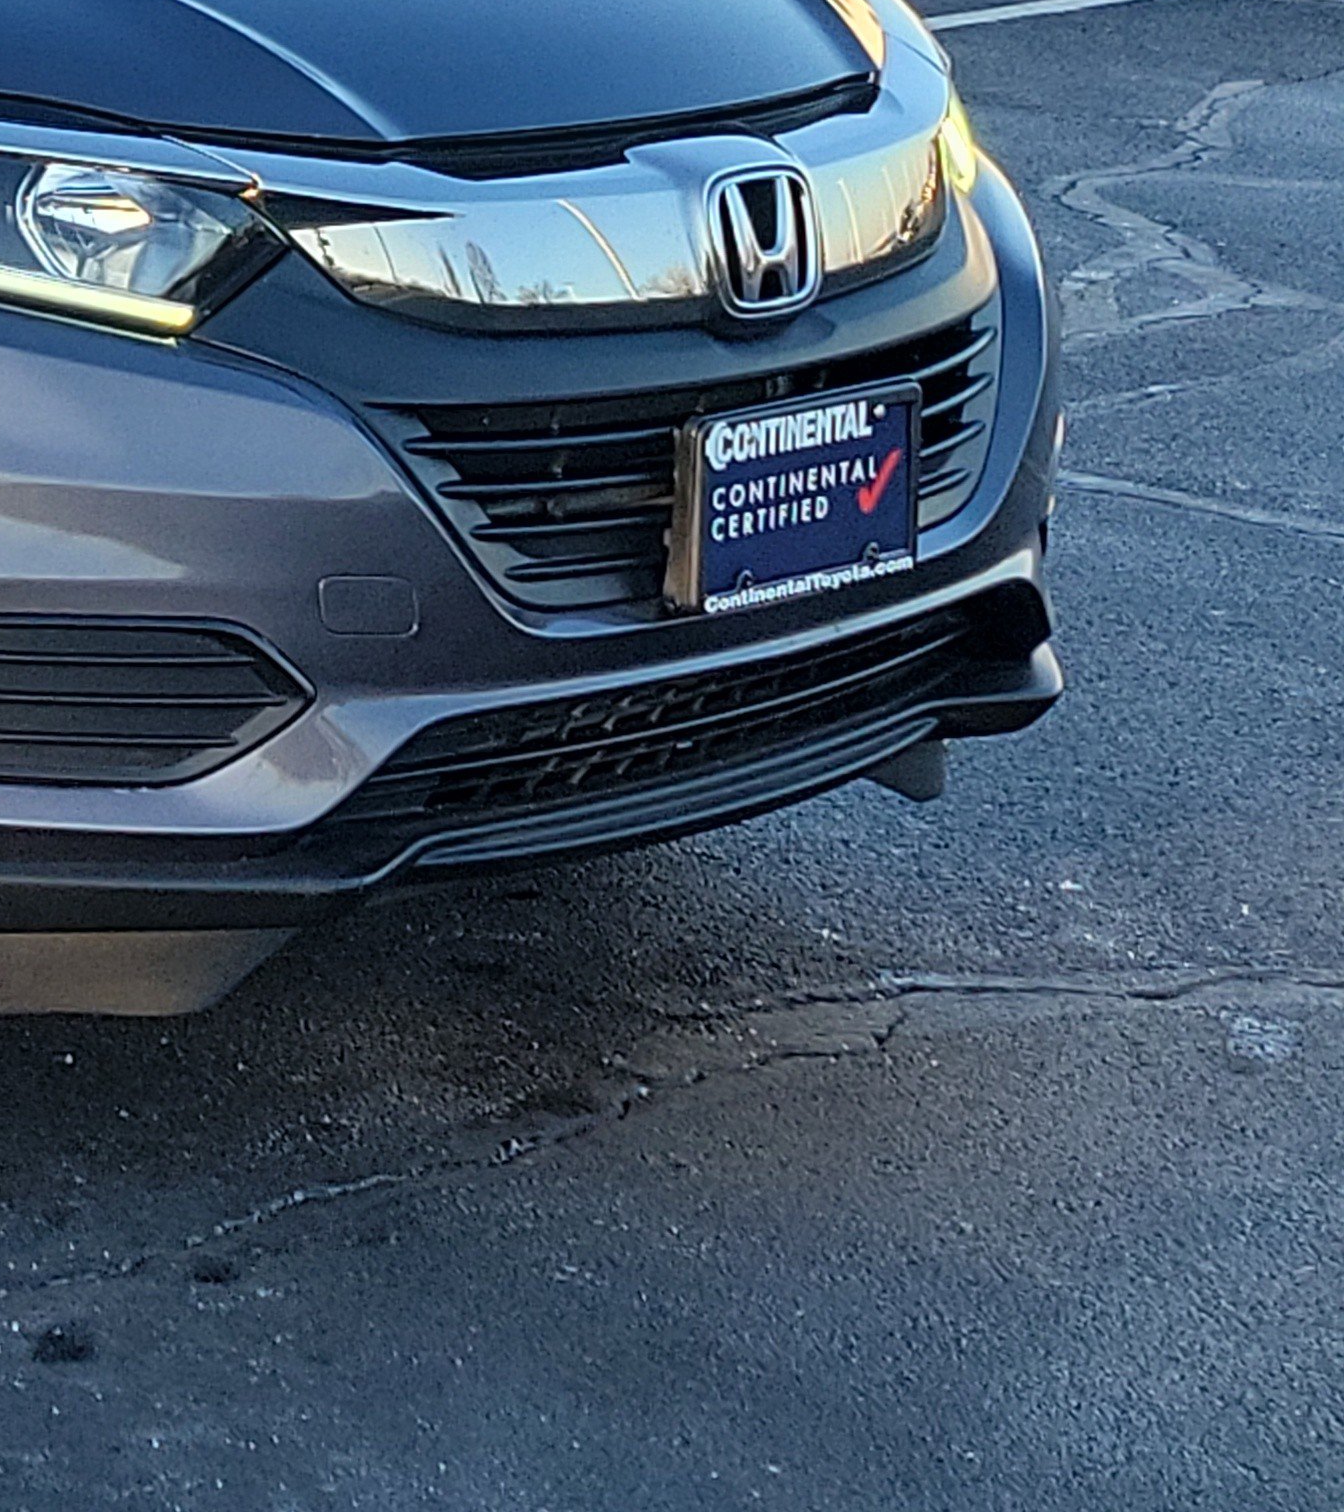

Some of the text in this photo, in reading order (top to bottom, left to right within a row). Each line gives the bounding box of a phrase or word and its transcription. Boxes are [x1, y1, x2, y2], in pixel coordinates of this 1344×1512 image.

[704, 400, 873, 472] CONTINENTAL
[712, 456, 879, 511] CONTINENTAL
[711, 496, 829, 543] CERTIFIED
[703, 554, 914, 614] ContinentalToyota.com
